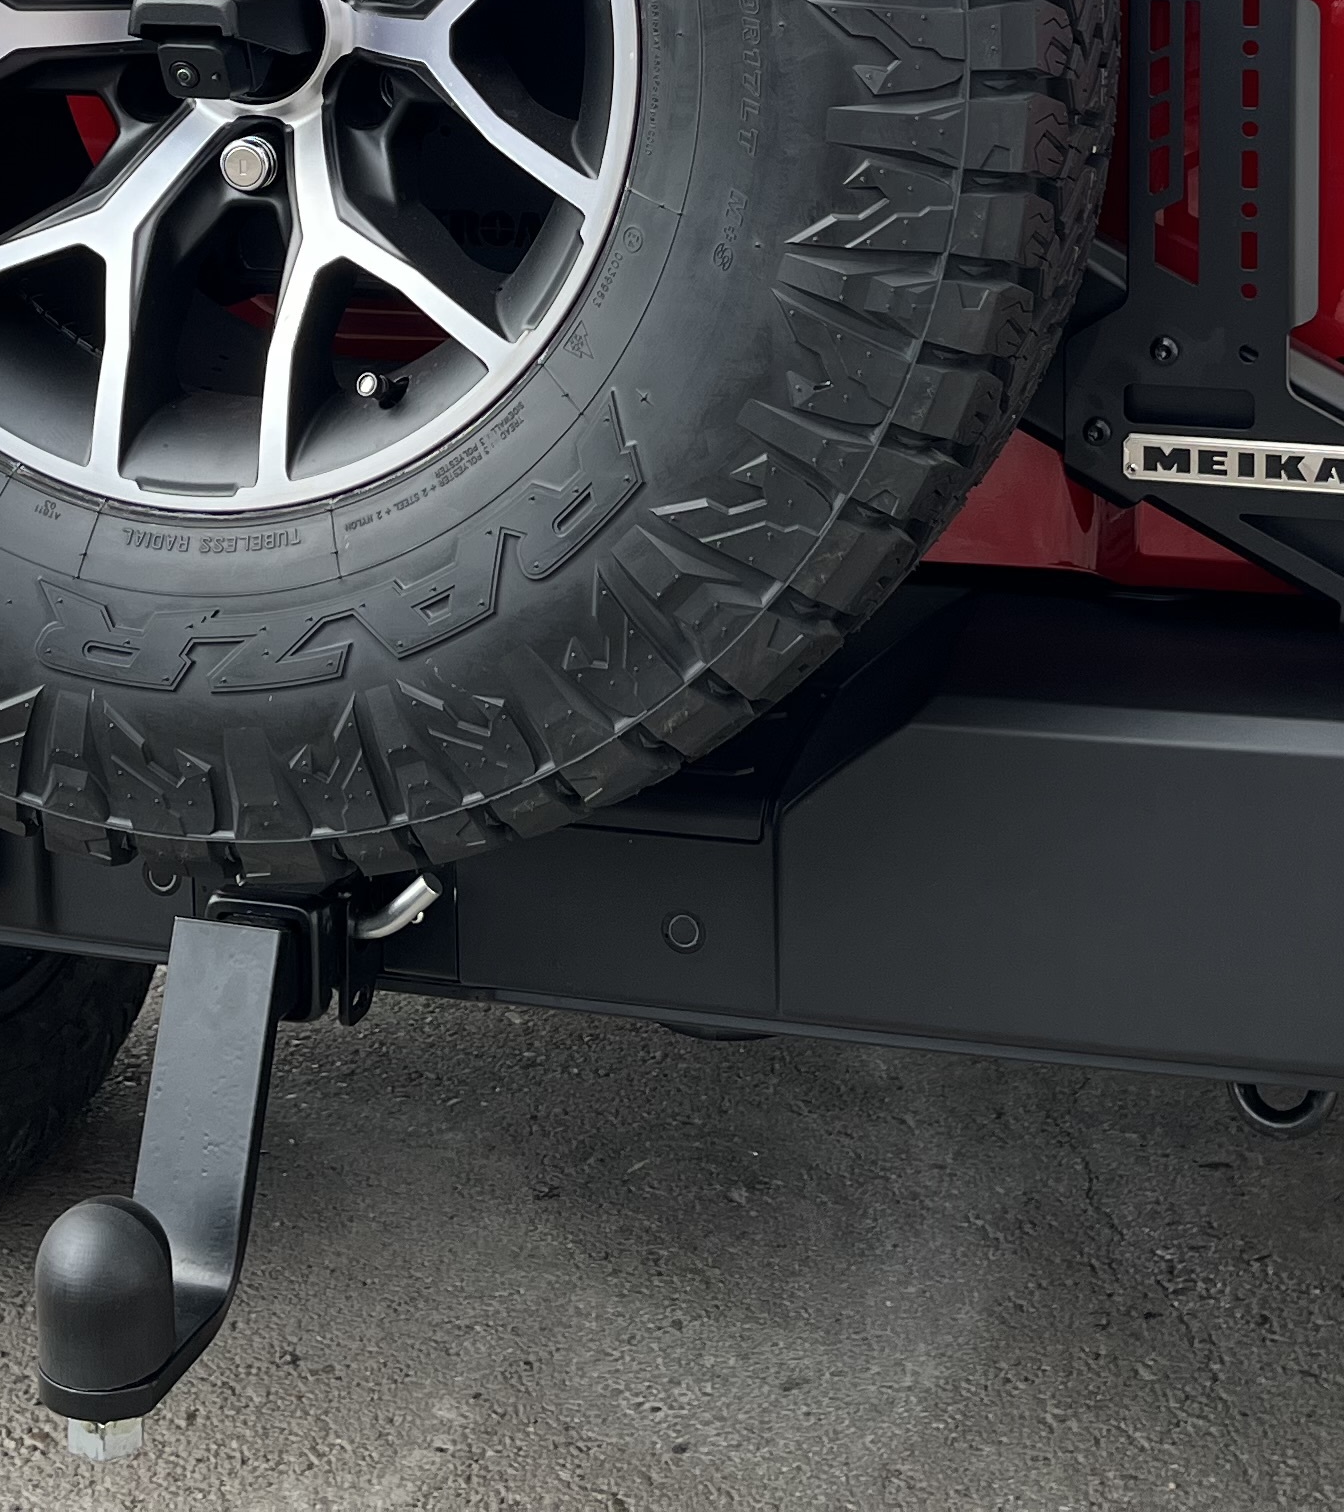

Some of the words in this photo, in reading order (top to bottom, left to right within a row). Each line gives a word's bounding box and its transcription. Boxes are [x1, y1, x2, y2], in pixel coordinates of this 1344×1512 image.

[34, 388, 650, 694] RAZR
[121, 527, 191, 553] RADIAL
[198, 526, 302, 555] TUBELESS
